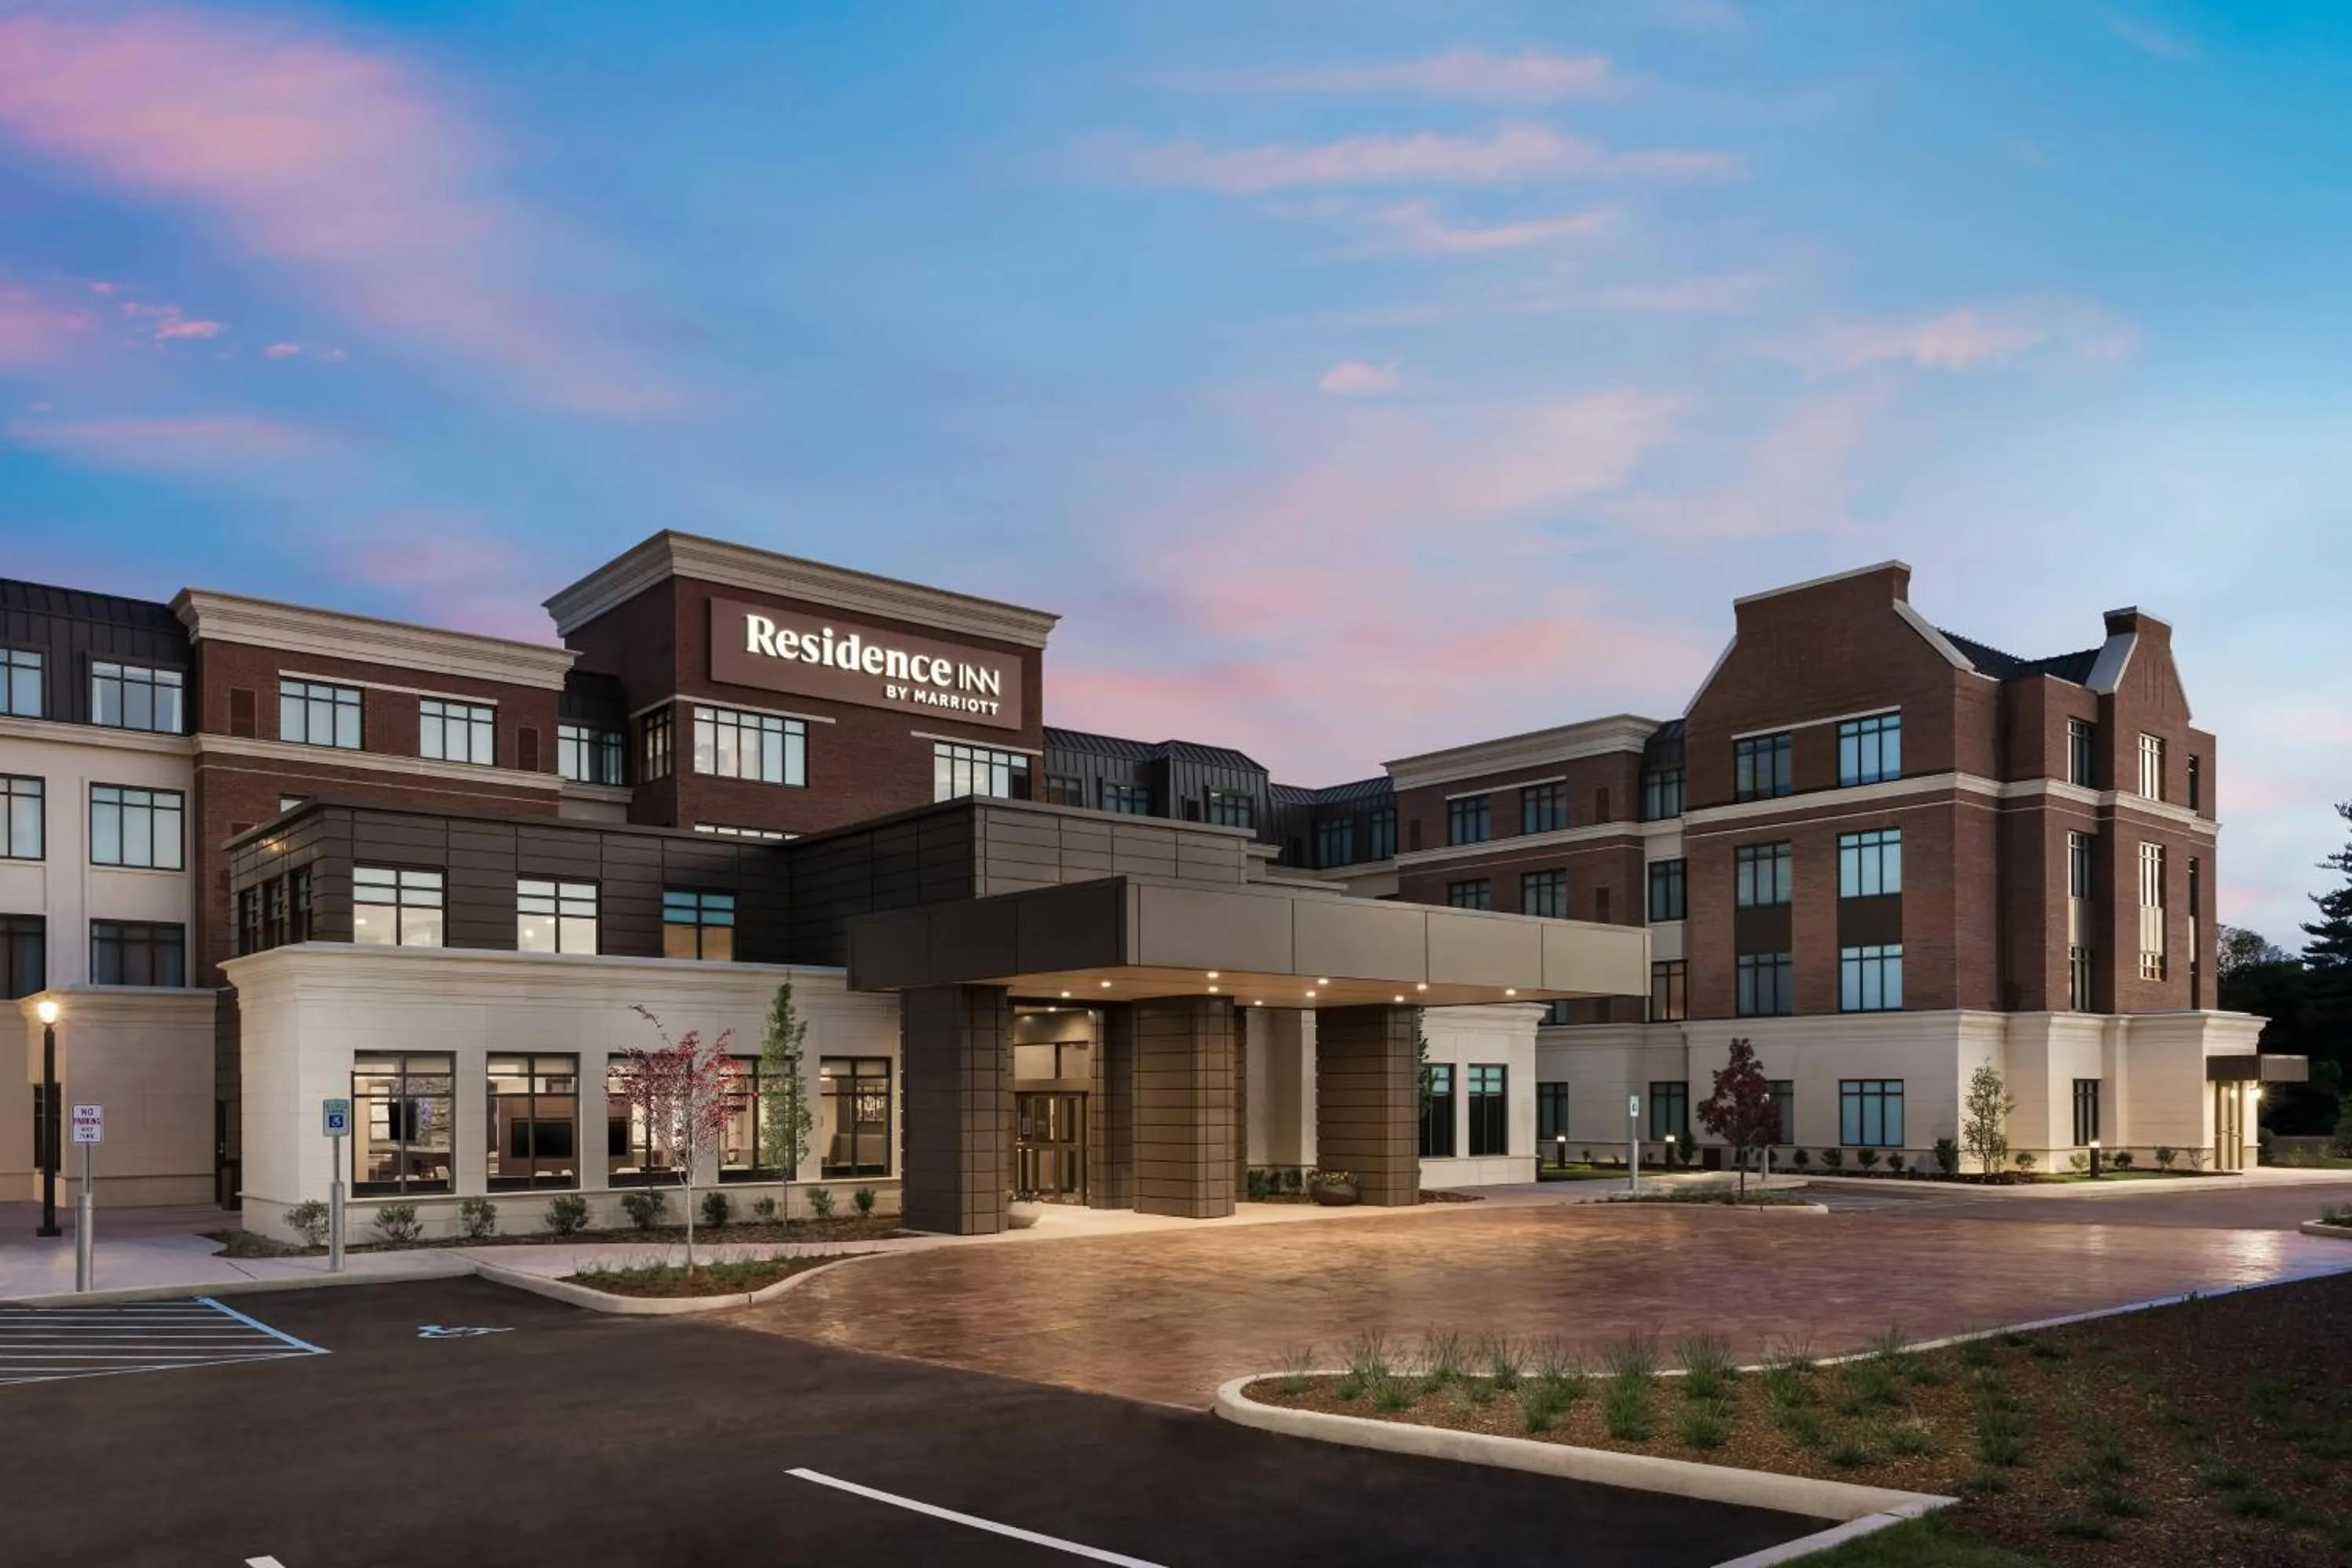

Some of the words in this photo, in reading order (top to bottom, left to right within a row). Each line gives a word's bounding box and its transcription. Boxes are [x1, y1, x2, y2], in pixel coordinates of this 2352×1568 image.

[746, 614, 953, 687] Residence
[958, 663, 1000, 696] INN
[886, 684, 909, 700] BY
[914, 688, 1000, 716] MARRIOTT
[81, 1107, 93, 1116] NO
